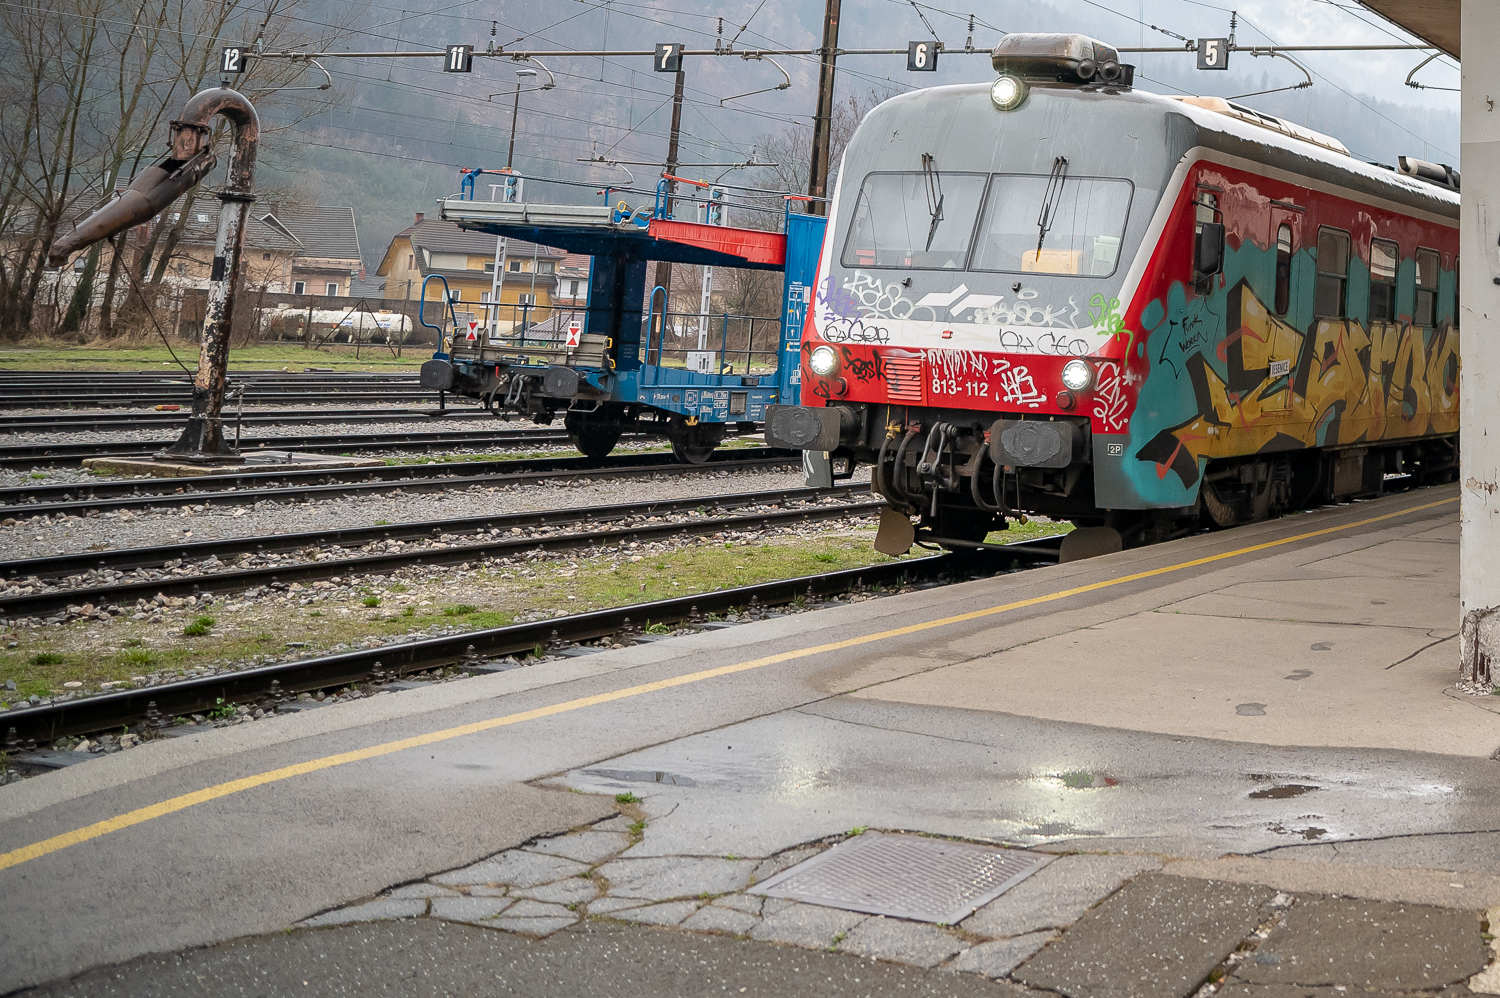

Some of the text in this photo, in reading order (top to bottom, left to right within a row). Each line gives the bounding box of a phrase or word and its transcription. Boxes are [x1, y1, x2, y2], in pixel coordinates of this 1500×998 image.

[223, 48, 239, 71] 12
[450, 46, 465, 70] 11
[661, 45, 673, 69] 7
[914, 43, 927, 68] 6
[1205, 40, 1218, 66] 5
[1110, 445, 1121, 454] 2P
